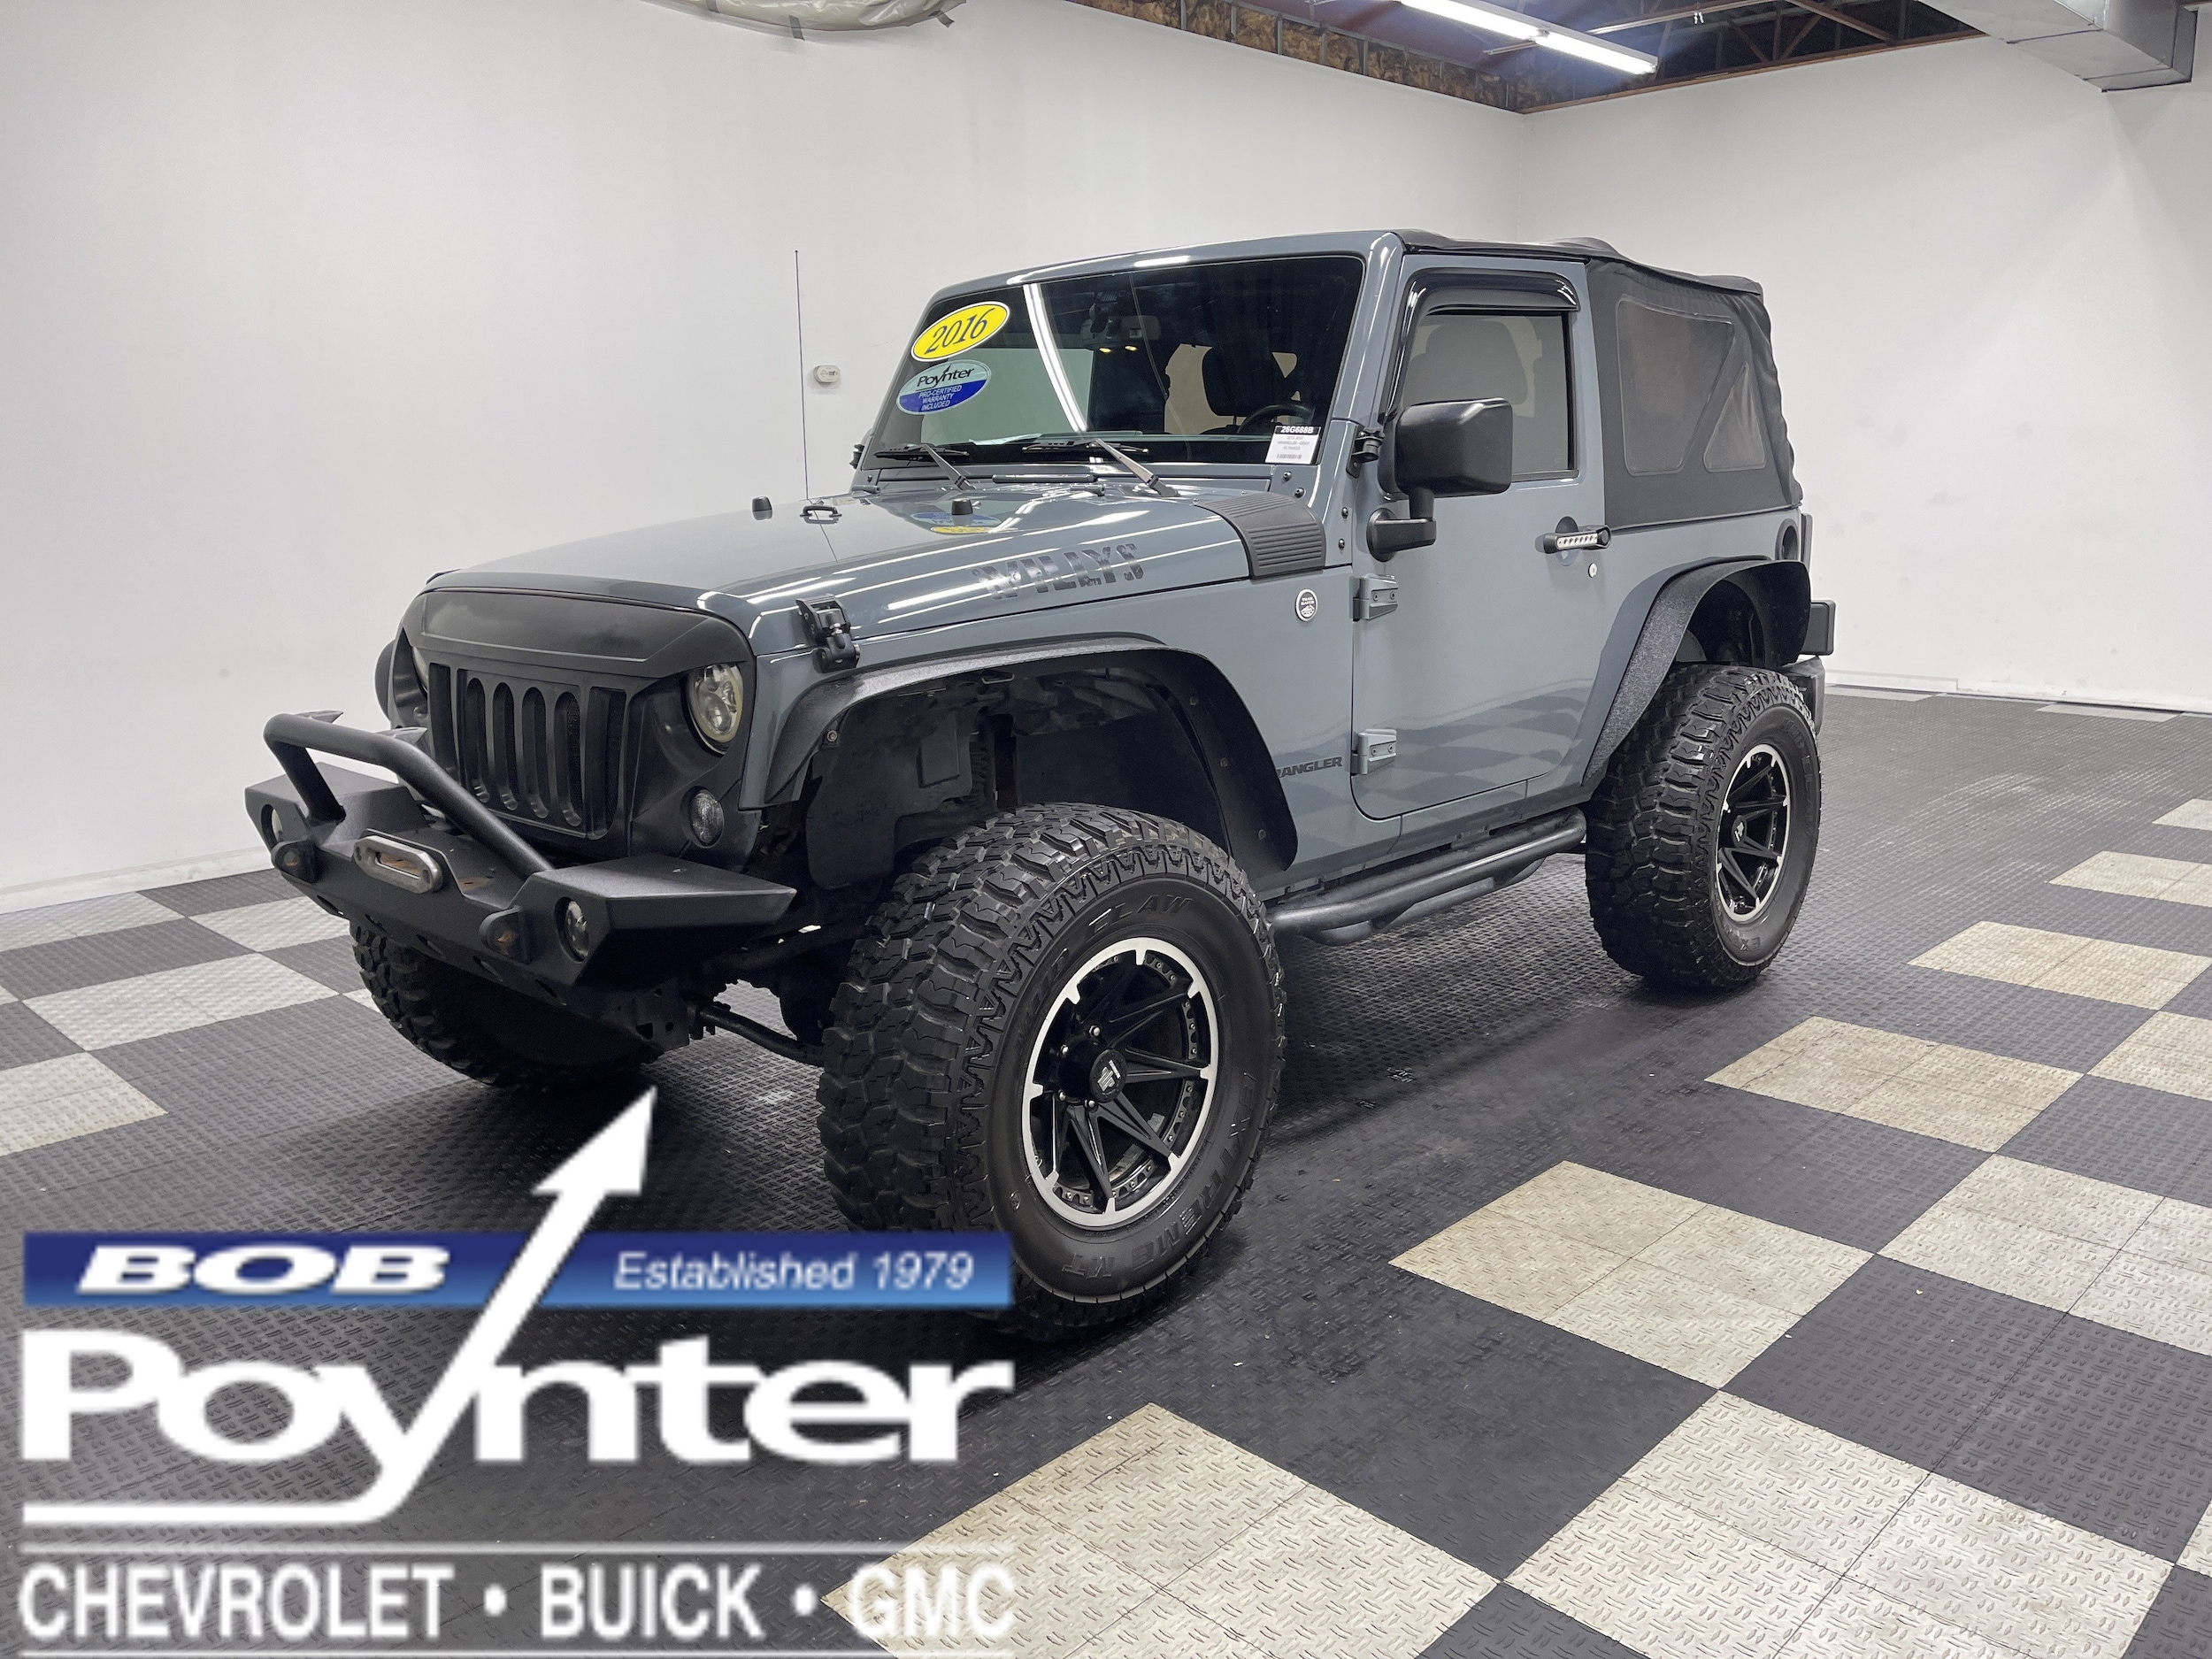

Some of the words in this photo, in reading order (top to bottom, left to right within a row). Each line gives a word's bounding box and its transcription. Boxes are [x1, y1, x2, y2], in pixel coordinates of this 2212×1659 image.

[924, 307, 995, 355] 2016
[916, 364, 975, 388] Poynter
[918, 384, 963, 399] PRO-CERTIFIED
[922, 392, 955, 404] WARRANTY
[920, 400, 951, 411] INCLUDED
[971, 542, 1145, 600] WILLYS
[1132, 1072, 1258, 1271] EXTREME
[1061, 1252, 1117, 1279] MT
